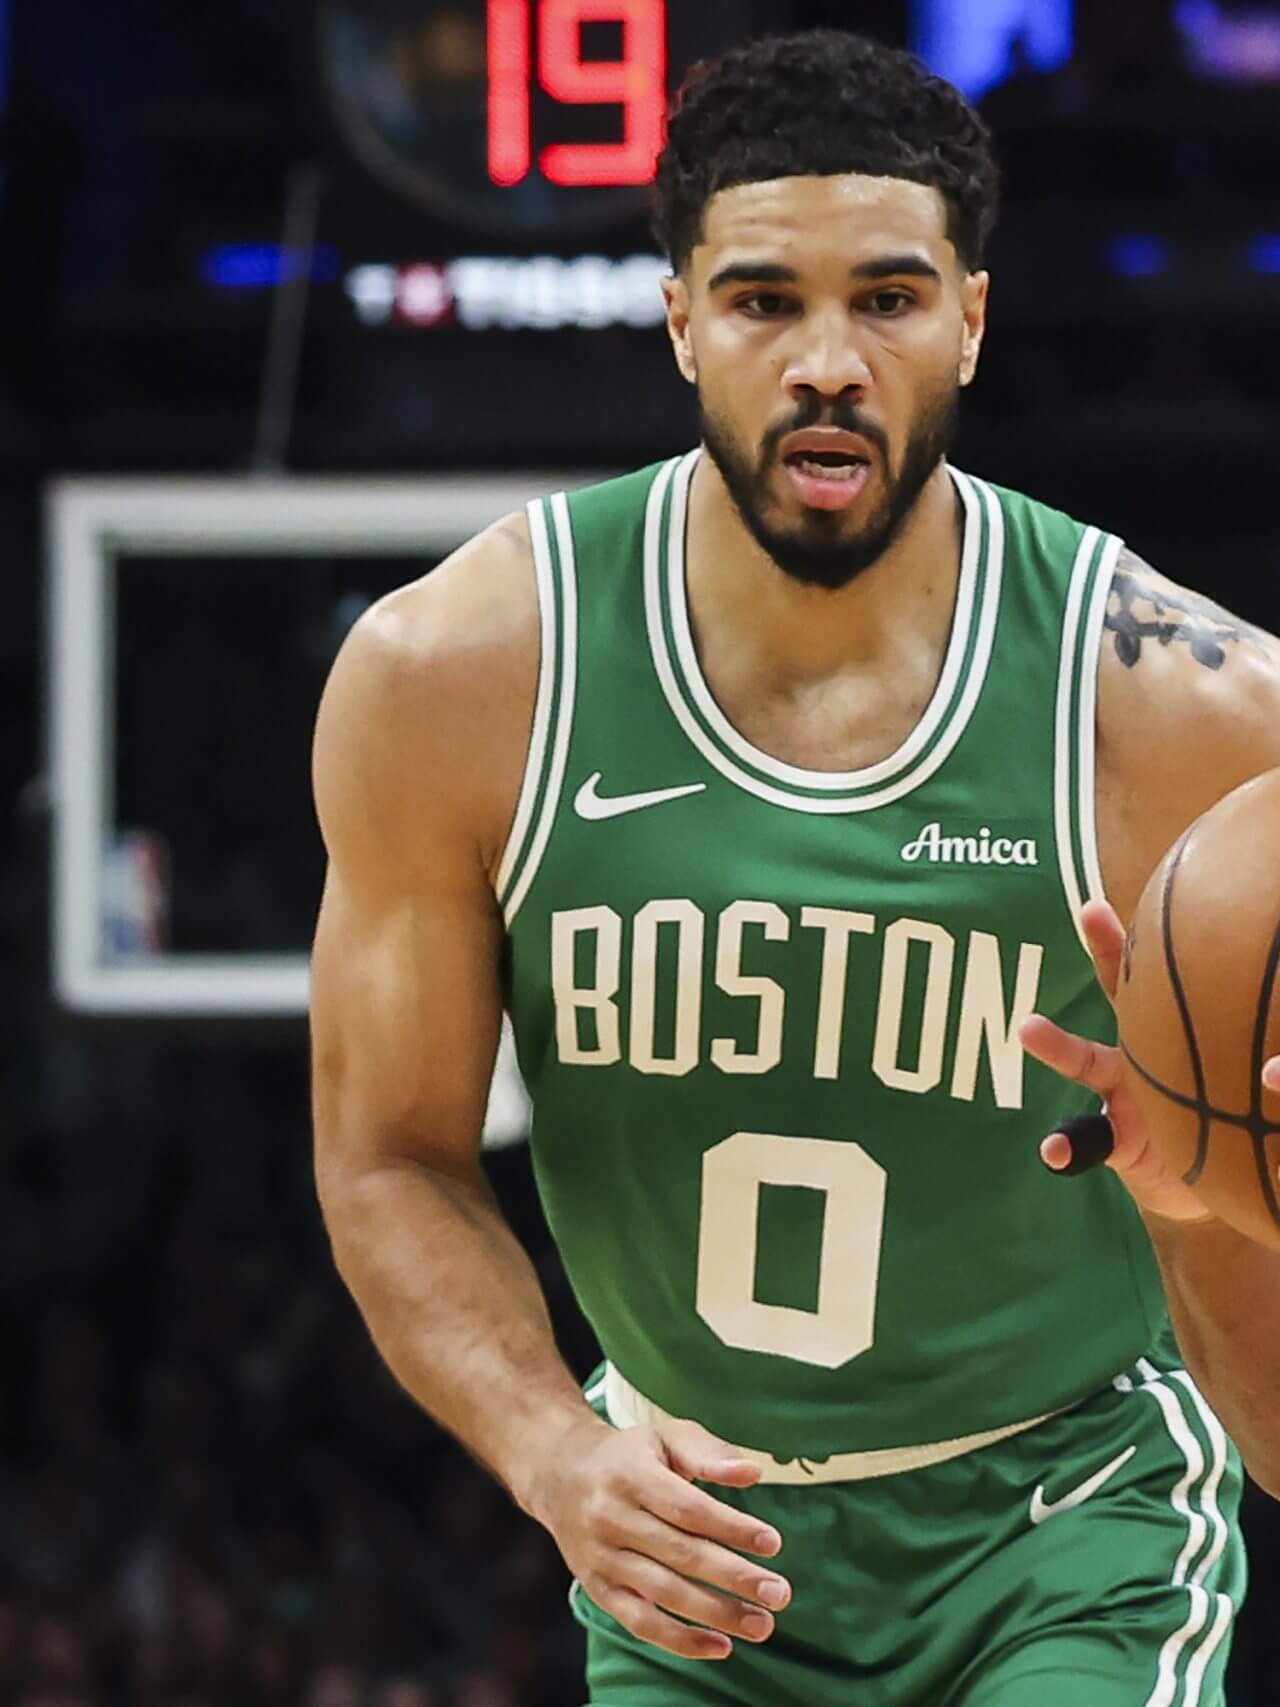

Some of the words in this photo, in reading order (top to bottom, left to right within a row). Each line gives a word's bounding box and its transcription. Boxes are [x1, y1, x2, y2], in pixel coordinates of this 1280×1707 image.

[487, 0, 668, 187] 19
[900, 822, 1039, 865] Amica
[551, 898, 1044, 1110] BOSTON
[695, 1131, 888, 1370] 0
